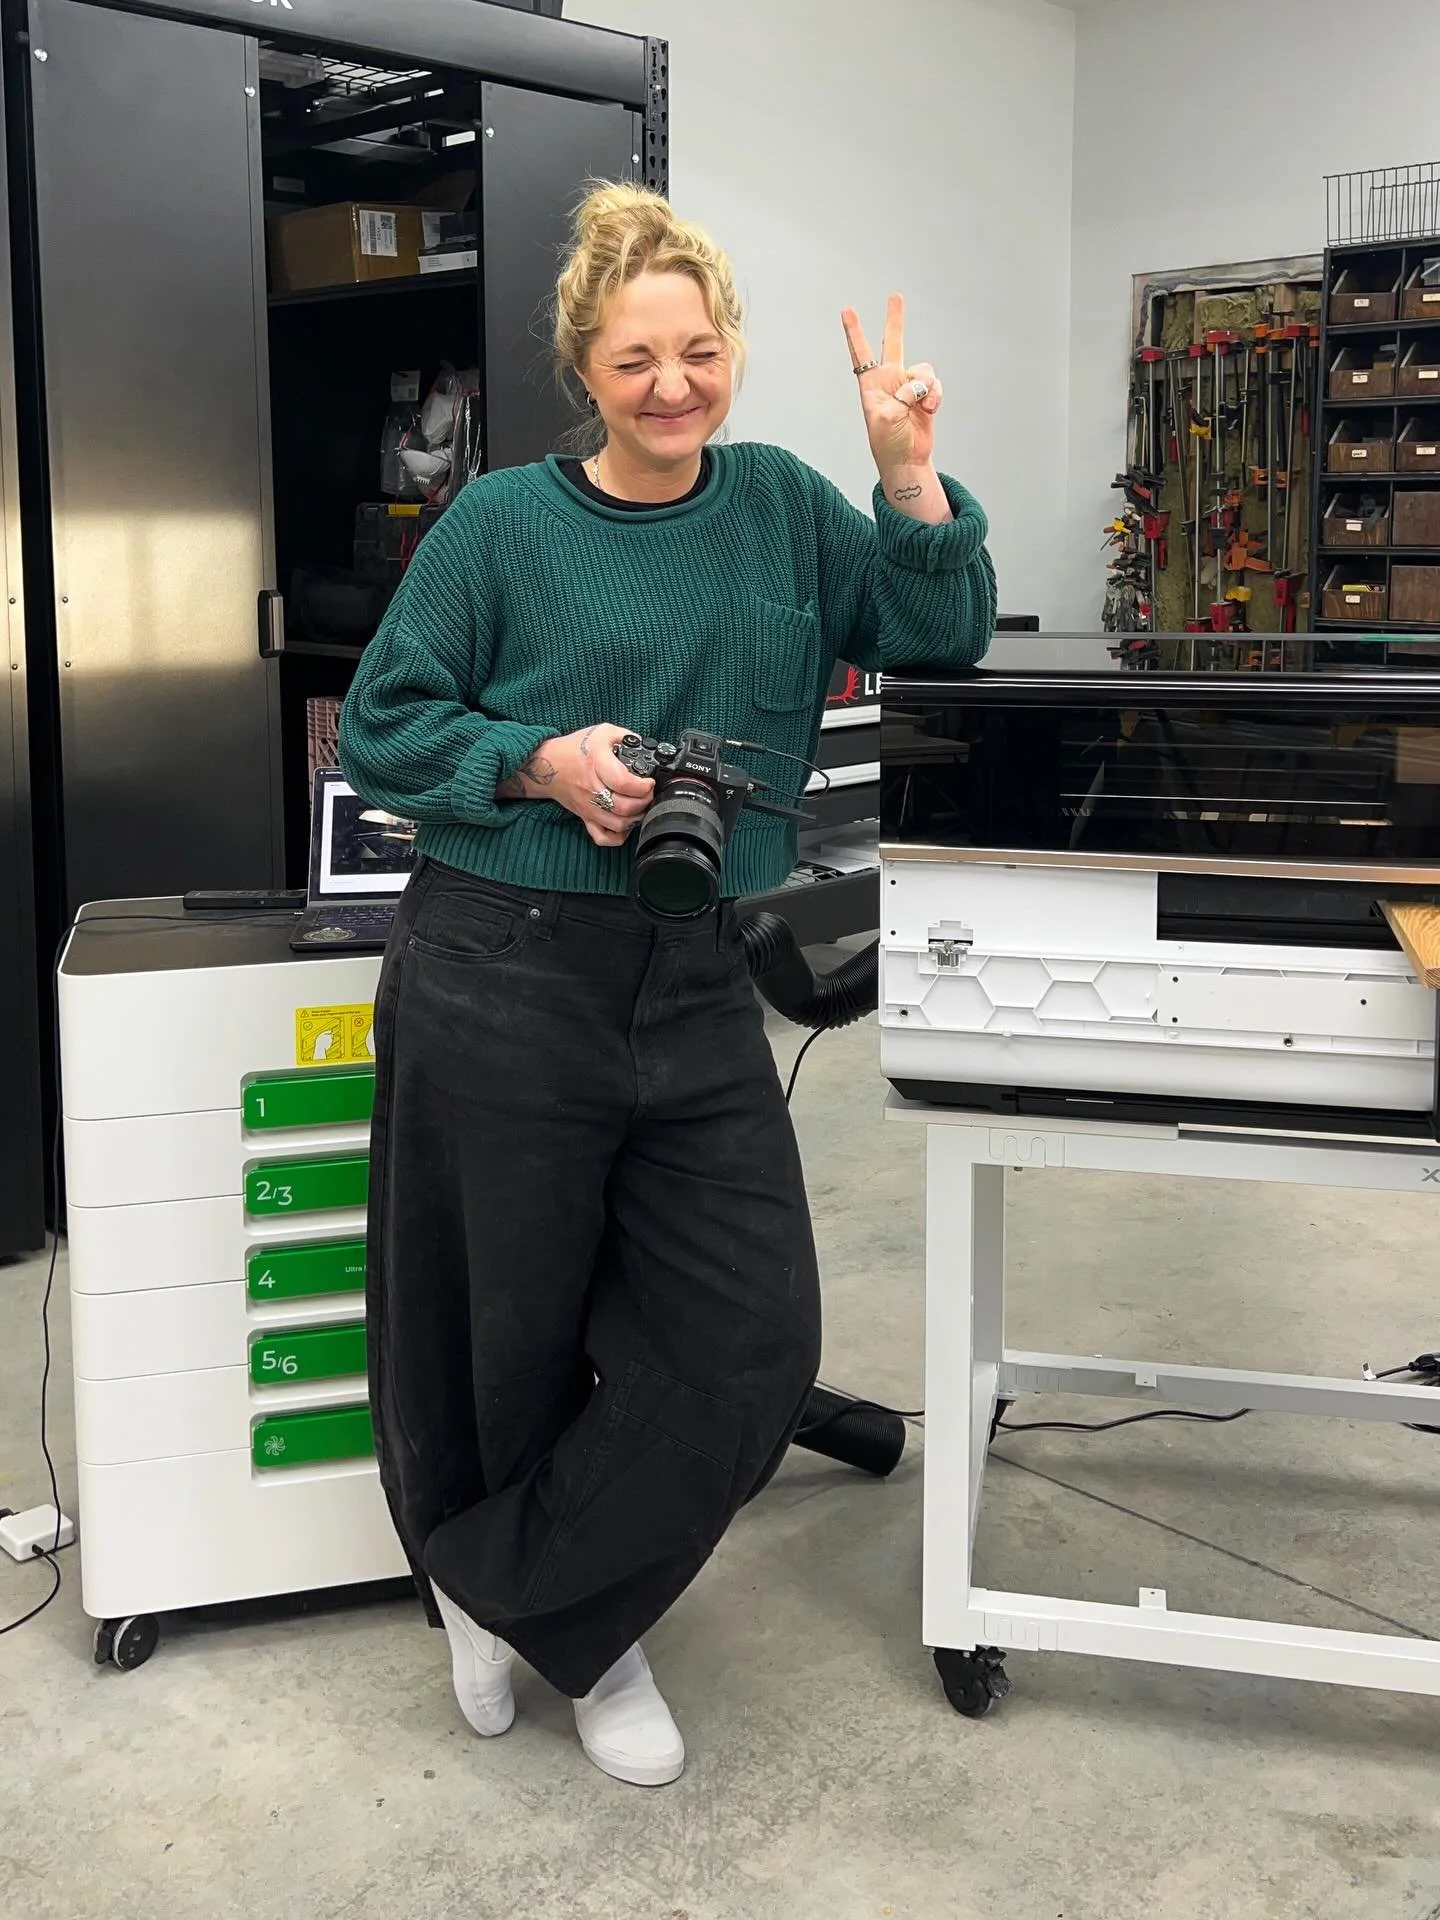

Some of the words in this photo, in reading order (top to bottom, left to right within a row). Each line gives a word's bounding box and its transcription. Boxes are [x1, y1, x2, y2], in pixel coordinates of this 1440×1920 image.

[685, 761, 712, 773] SONY
[255, 1097, 265, 1118] 1
[256, 1180, 293, 1206] 2/3
[257, 1269, 276, 1289] 4
[345, 1265, 363, 1273] Ultra
[261, 1350, 298, 1375] 5/6
